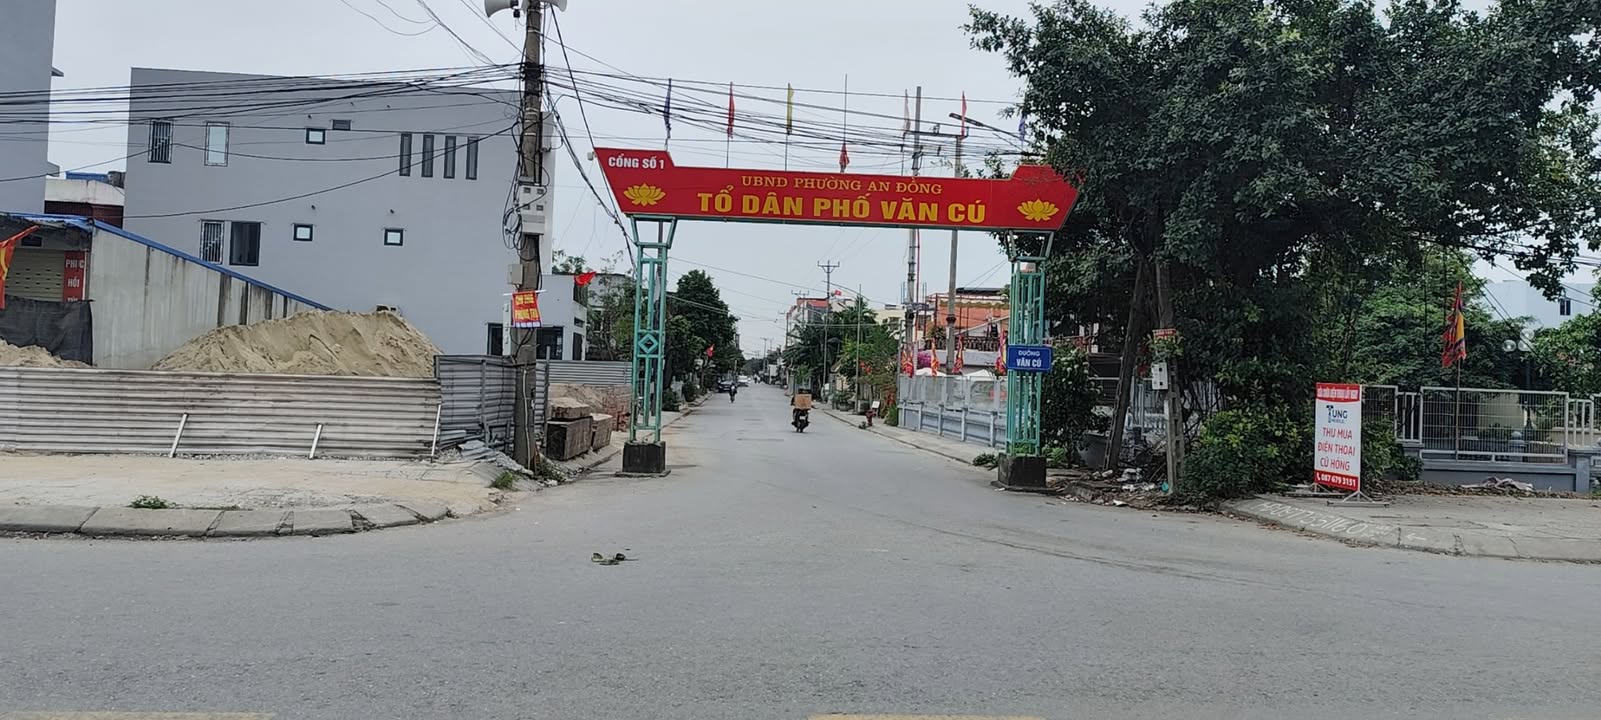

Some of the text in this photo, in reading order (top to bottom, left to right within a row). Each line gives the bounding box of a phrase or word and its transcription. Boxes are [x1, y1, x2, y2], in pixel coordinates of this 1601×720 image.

[608, 153, 665, 169] CỔNG SỐ 1
[742, 175, 788, 188] UBND
[794, 176, 862, 191] PHƯỜNG
[868, 181, 890, 192] AN
[697, 184, 986, 223] TỔ DÂN PHỐ VĂN CÚ
[1323, 427, 1353, 440] THU MUA
